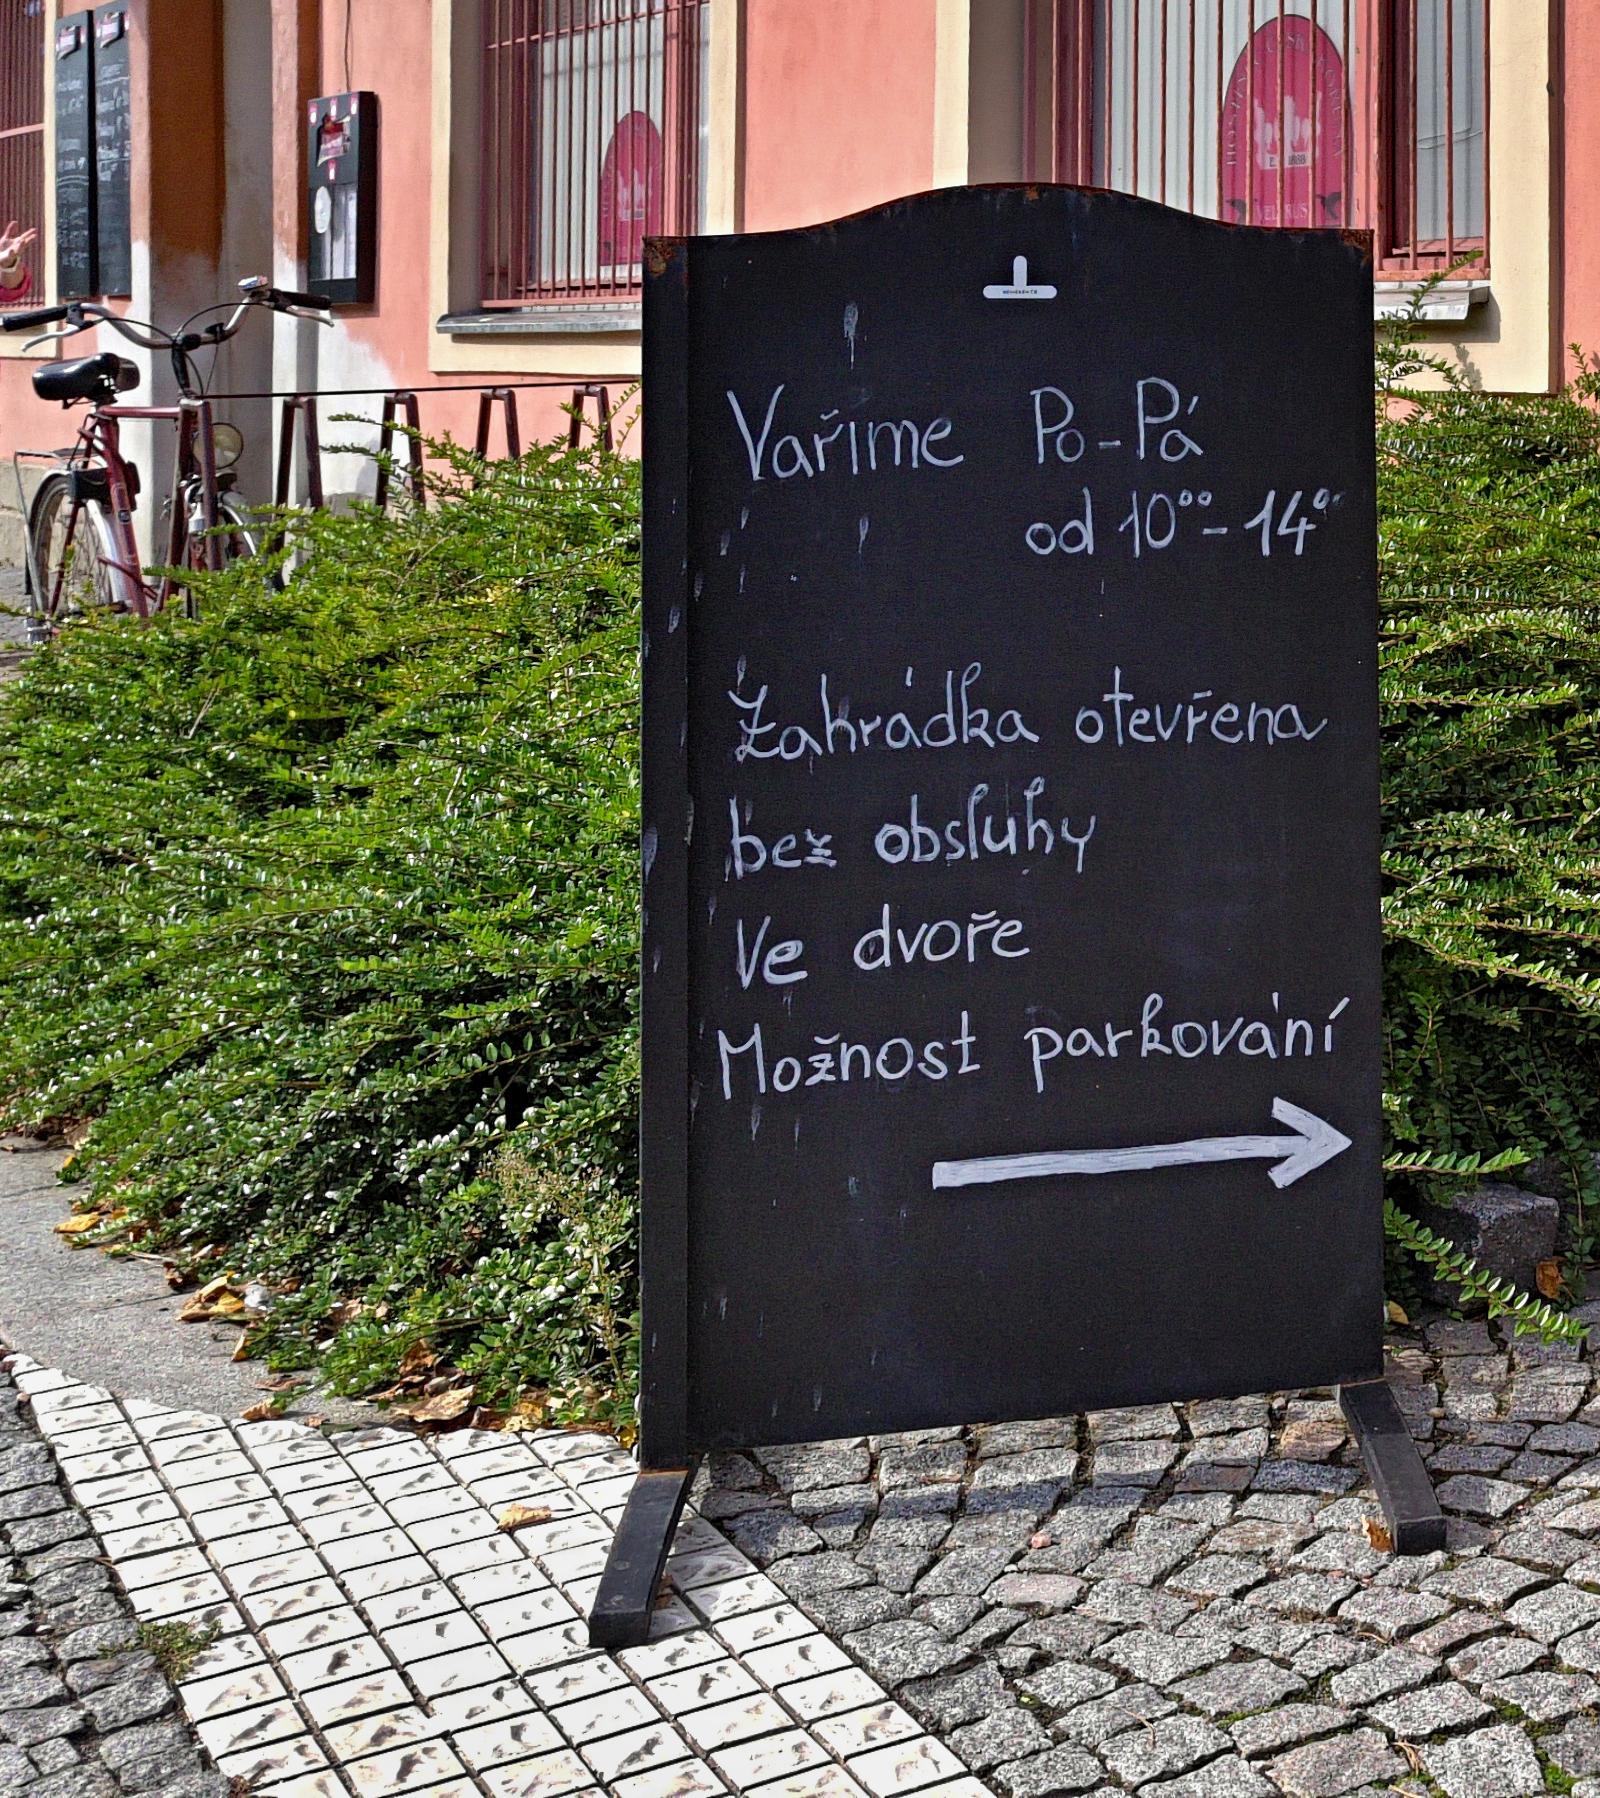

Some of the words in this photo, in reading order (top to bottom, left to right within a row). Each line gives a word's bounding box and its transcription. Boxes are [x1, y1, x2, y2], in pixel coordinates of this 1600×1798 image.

[1026, 488, 1094, 555] od
[729, 796, 837, 880] bez
[874, 776, 1096, 874] obsluhy
[736, 915, 808, 990] Ve
[853, 903, 1030, 971] dvoře
[717, 1010, 981, 1100] Možnost
[1023, 992, 1350, 1094] parkování
